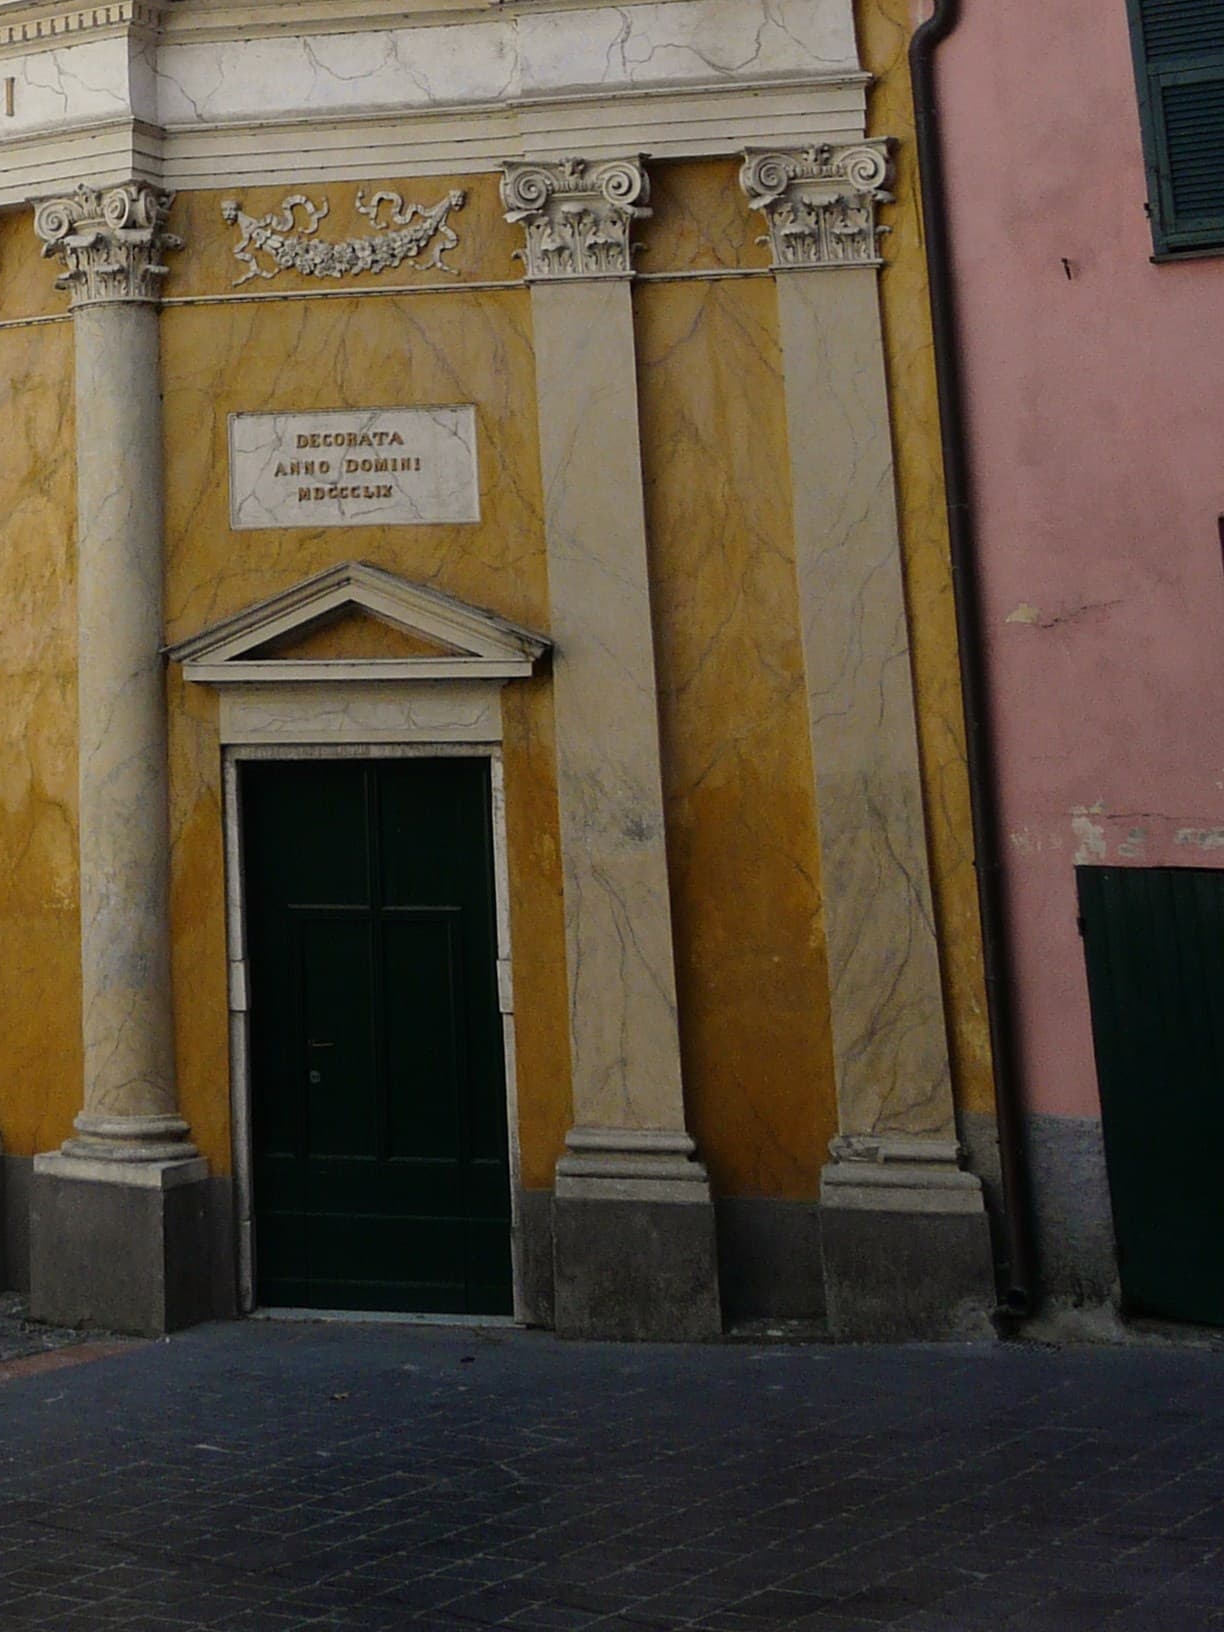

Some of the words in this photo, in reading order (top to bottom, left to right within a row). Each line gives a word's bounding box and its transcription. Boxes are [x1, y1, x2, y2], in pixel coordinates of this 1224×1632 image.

[296, 431, 404, 449] DECORATA
[274, 459, 330, 477] ANNO
[345, 457, 421, 473] DOMINI
[298, 485, 392, 502] MDCCCLIX
